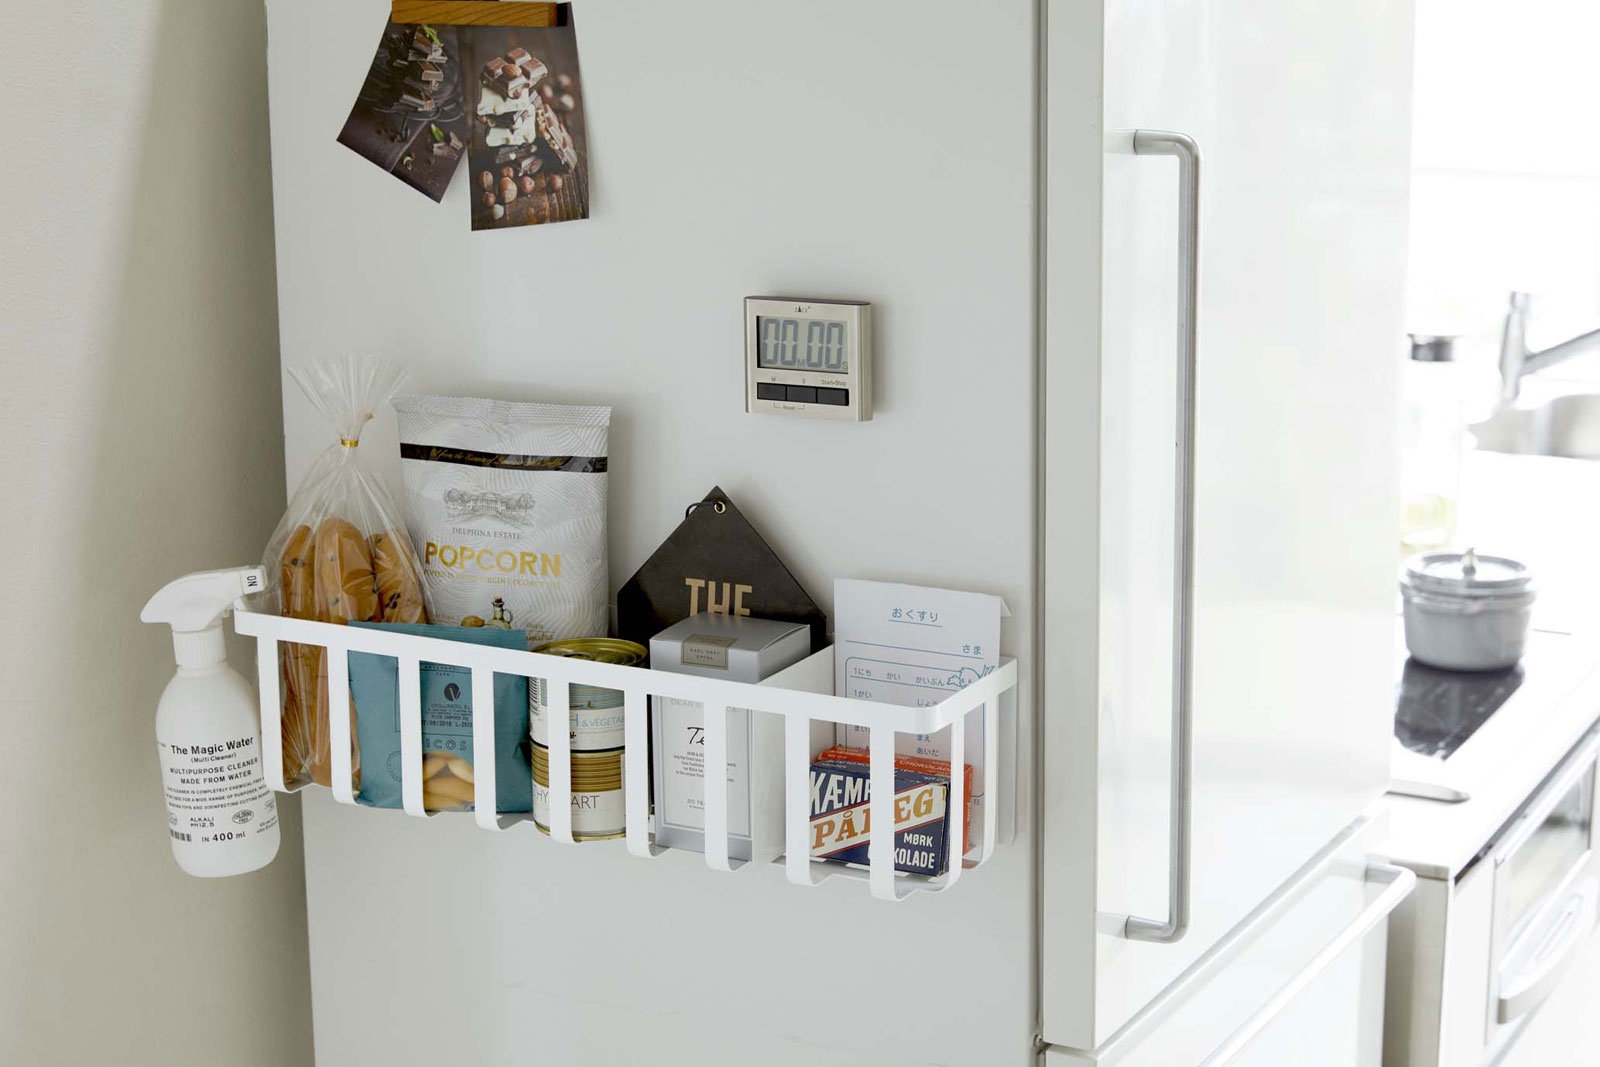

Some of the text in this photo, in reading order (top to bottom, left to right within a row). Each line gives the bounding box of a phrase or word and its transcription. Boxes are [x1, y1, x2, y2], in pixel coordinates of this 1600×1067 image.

[452, 527, 522, 540] DELPHINA ESTATE
[425, 541, 563, 577] POPCORN
[246, 575, 258, 587] ON
[685, 578, 752, 617] THE
[892, 607, 938, 622] おくすり
[962, 643, 982, 655] さま
[853, 667, 945, 687] 1にち かい かいぶん
[853, 689, 872, 699] 1かい
[171, 744, 188, 755] The
[191, 744, 224, 756] Magic
[226, 737, 254, 750] Water
[916, 747, 939, 757] あいだ
[170, 757, 258, 775] MULTIPURPOSE CLEANER
[180, 769, 252, 785] MADE FROM WATER
[196, 787, 228, 795] COMPLETELY
[571, 795, 600, 809] ART
[212, 832, 234, 842] 400
[236, 831, 246, 840] ml
[903, 832, 933, 847] MØRK
